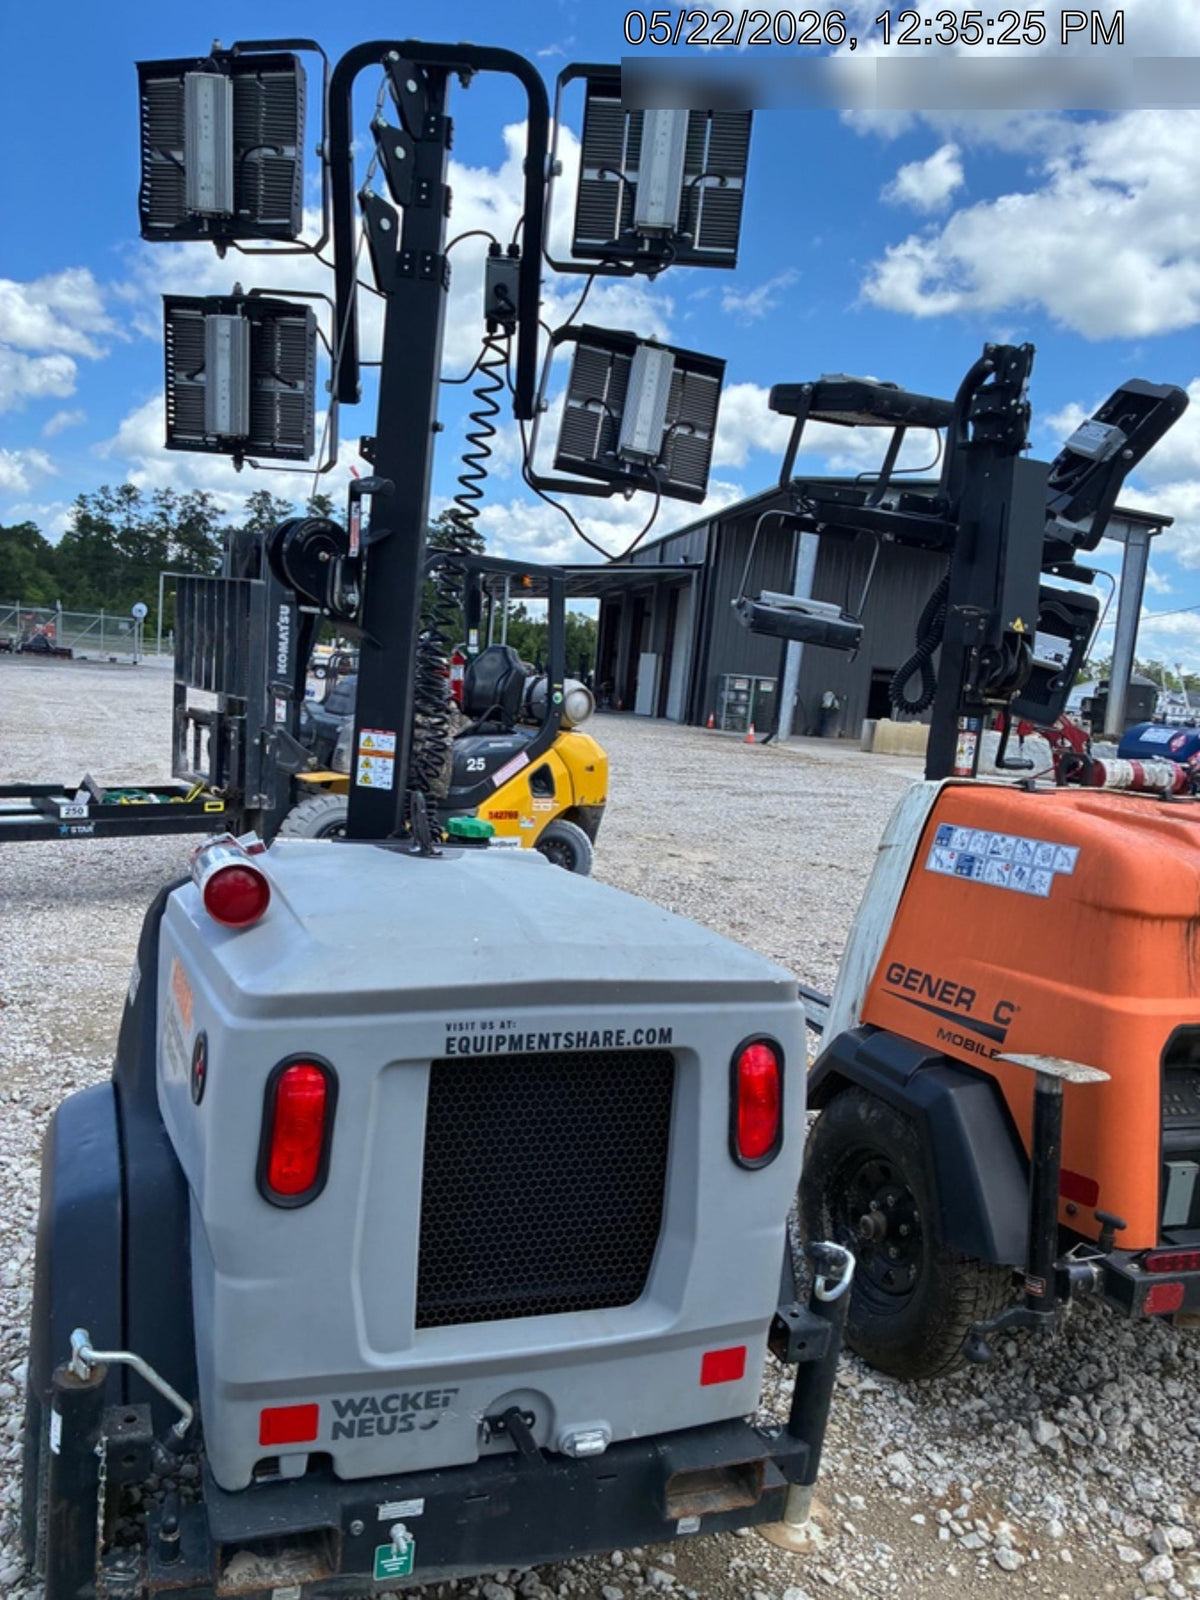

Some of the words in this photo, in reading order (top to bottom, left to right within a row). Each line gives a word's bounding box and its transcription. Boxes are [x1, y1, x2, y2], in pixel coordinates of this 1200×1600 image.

[277, 604, 290, 674] KOMATSU
[466, 757, 486, 771] 25
[64, 806, 84, 815] 250
[445, 1022, 475, 1032] VISIT
[480, 1021, 494, 1030] US
[499, 1020, 516, 1029] AT:
[445, 1027, 673, 1054] EQUIPMENTSHARE.COM
